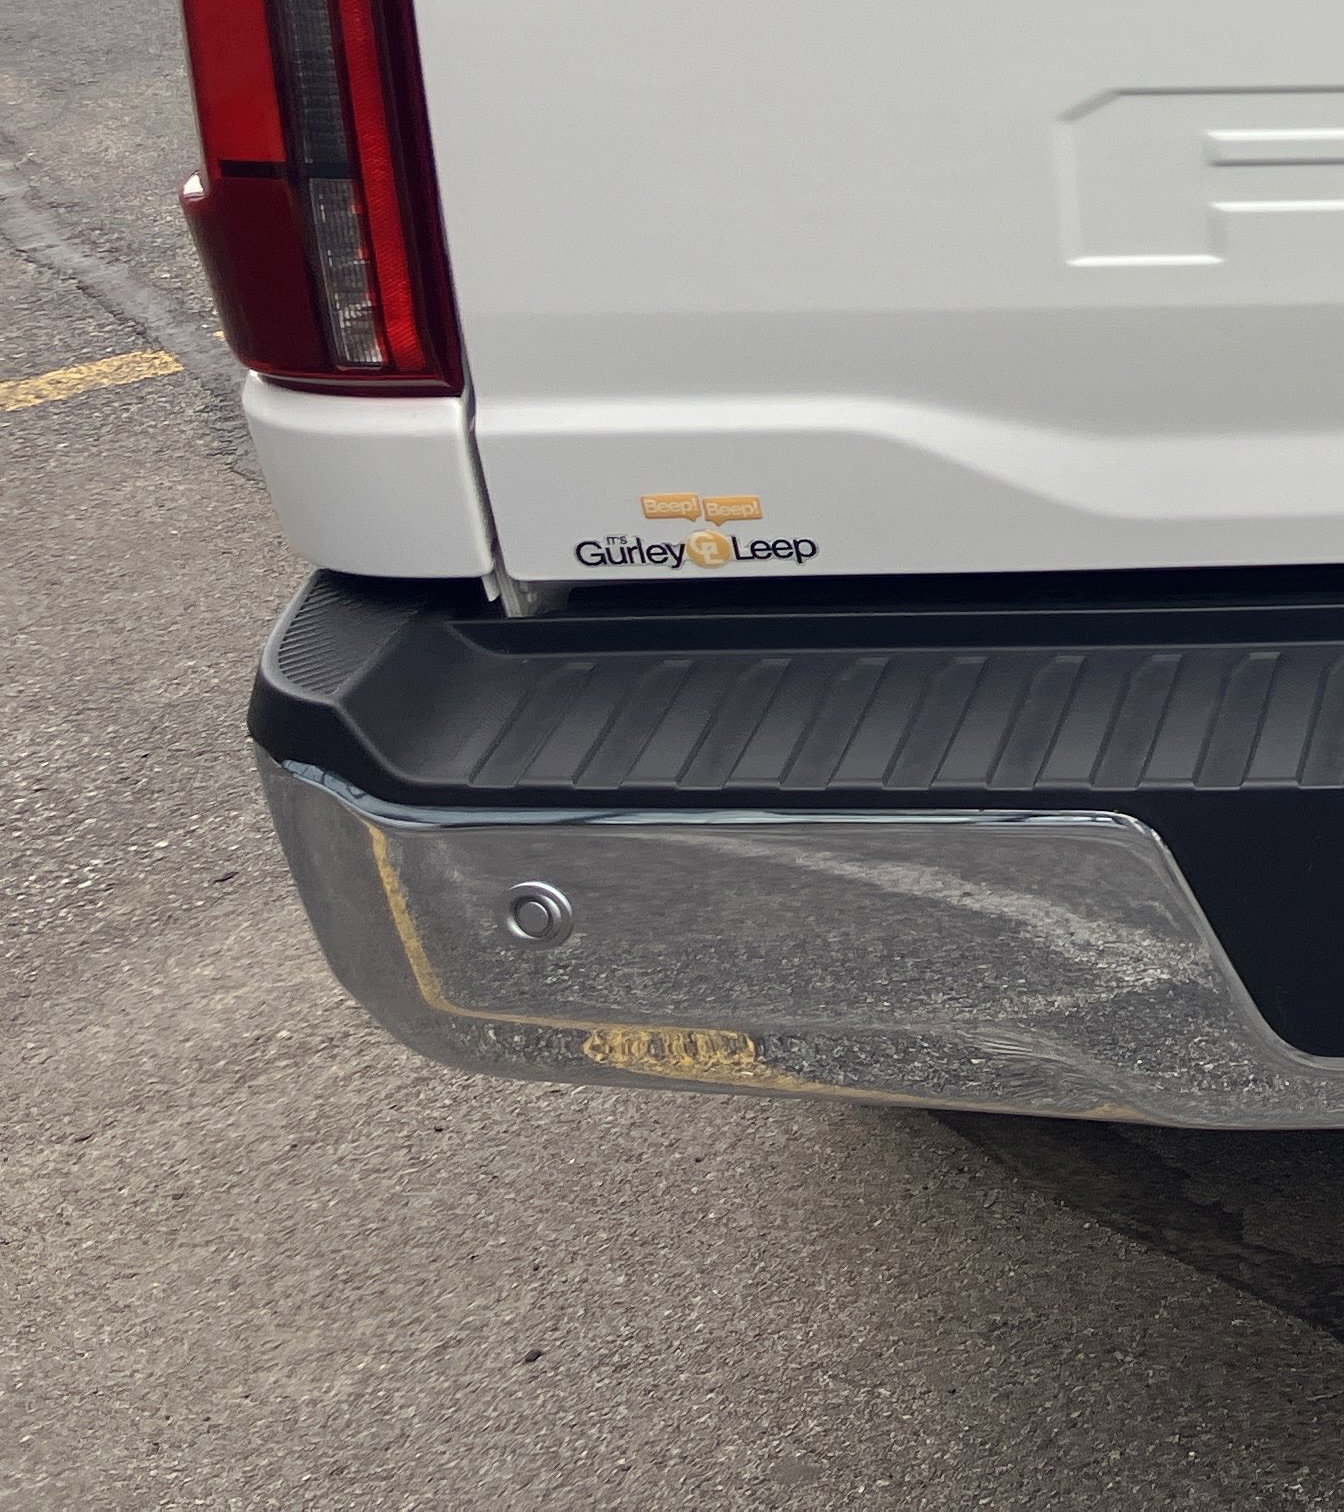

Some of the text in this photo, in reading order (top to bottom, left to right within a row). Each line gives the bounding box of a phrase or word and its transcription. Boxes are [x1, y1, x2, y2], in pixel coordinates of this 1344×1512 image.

[643, 496, 760, 517] Beep! Beep!
[575, 537, 686, 569] Gurley
[731, 536, 817, 564] Leep
